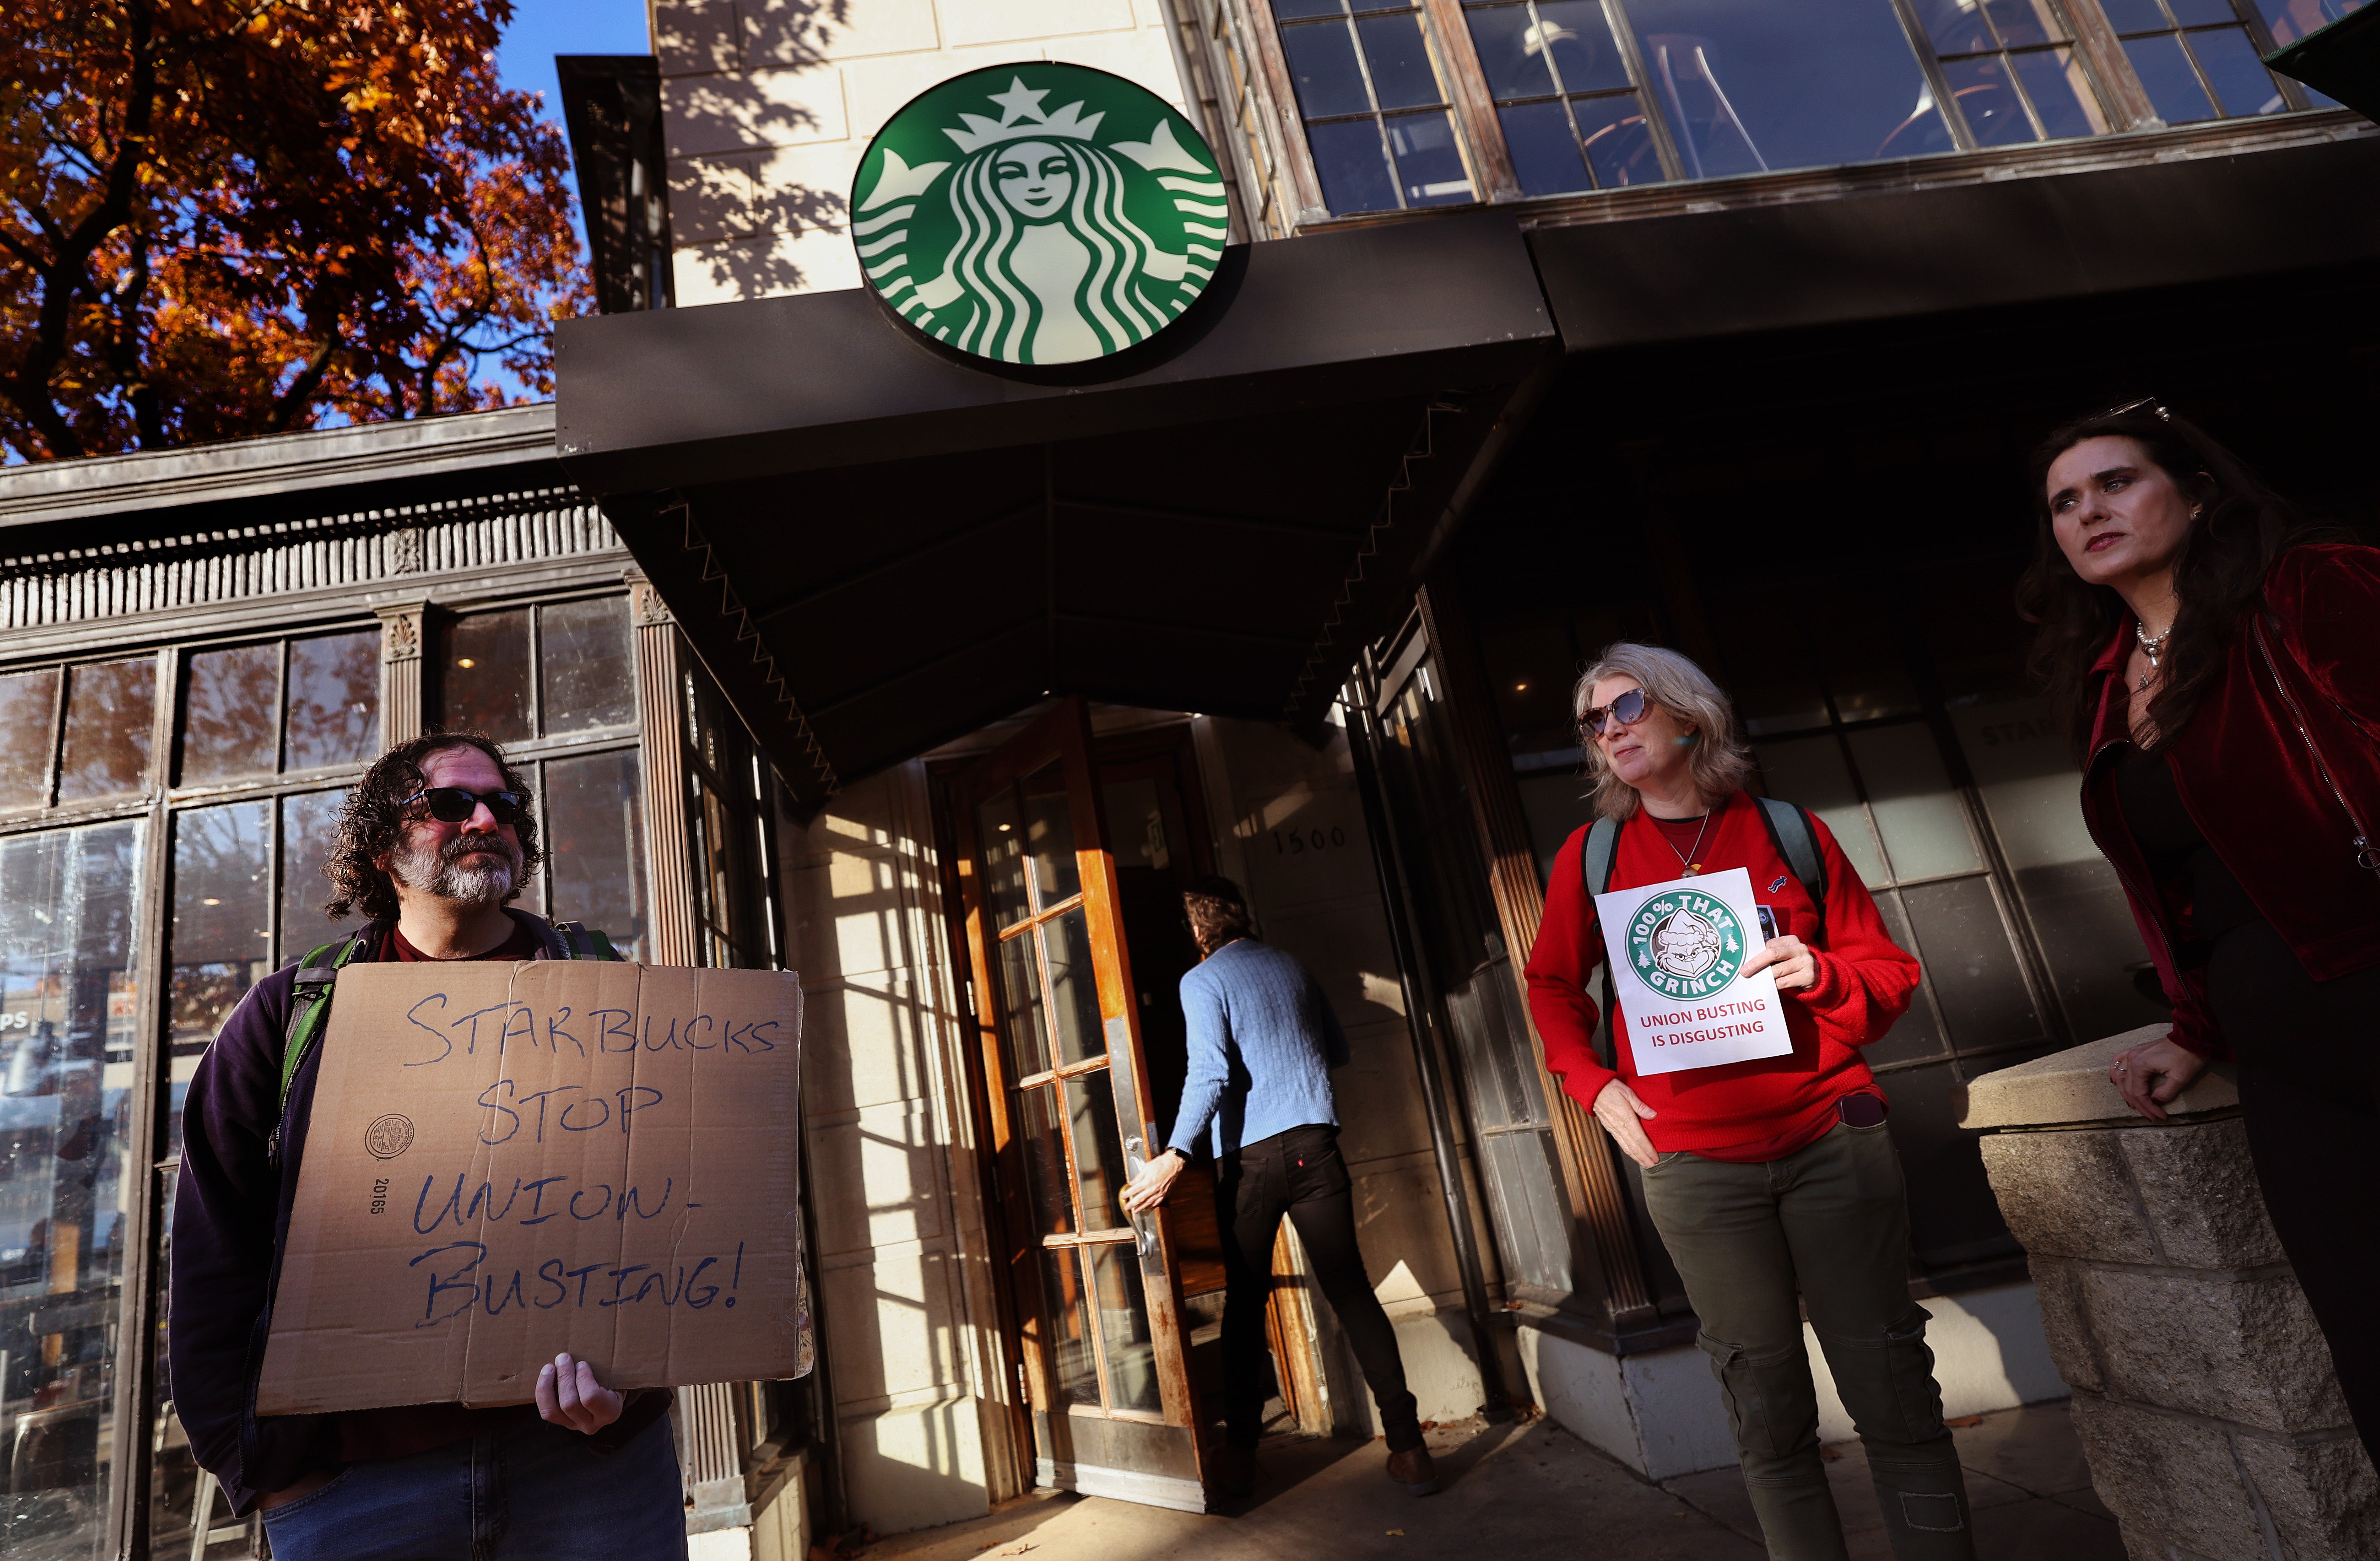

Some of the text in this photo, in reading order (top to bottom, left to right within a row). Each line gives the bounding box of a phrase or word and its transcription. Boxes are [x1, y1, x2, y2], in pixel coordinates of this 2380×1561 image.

[1273, 826, 1344, 856] 1500
[1633, 895, 1735, 945] 100% THAT
[1650, 959, 1735, 995] GRINCH
[404, 993, 780, 1066] STARBUCKS
[1640, 999, 1766, 1028] UNION BUSTING
[1651, 1021, 1764, 1047] IS DISGUSTING
[477, 1080, 664, 1145] STOP
[371, 1178, 390, 1214] 20165
[409, 1241, 745, 1329] BUSTING!
